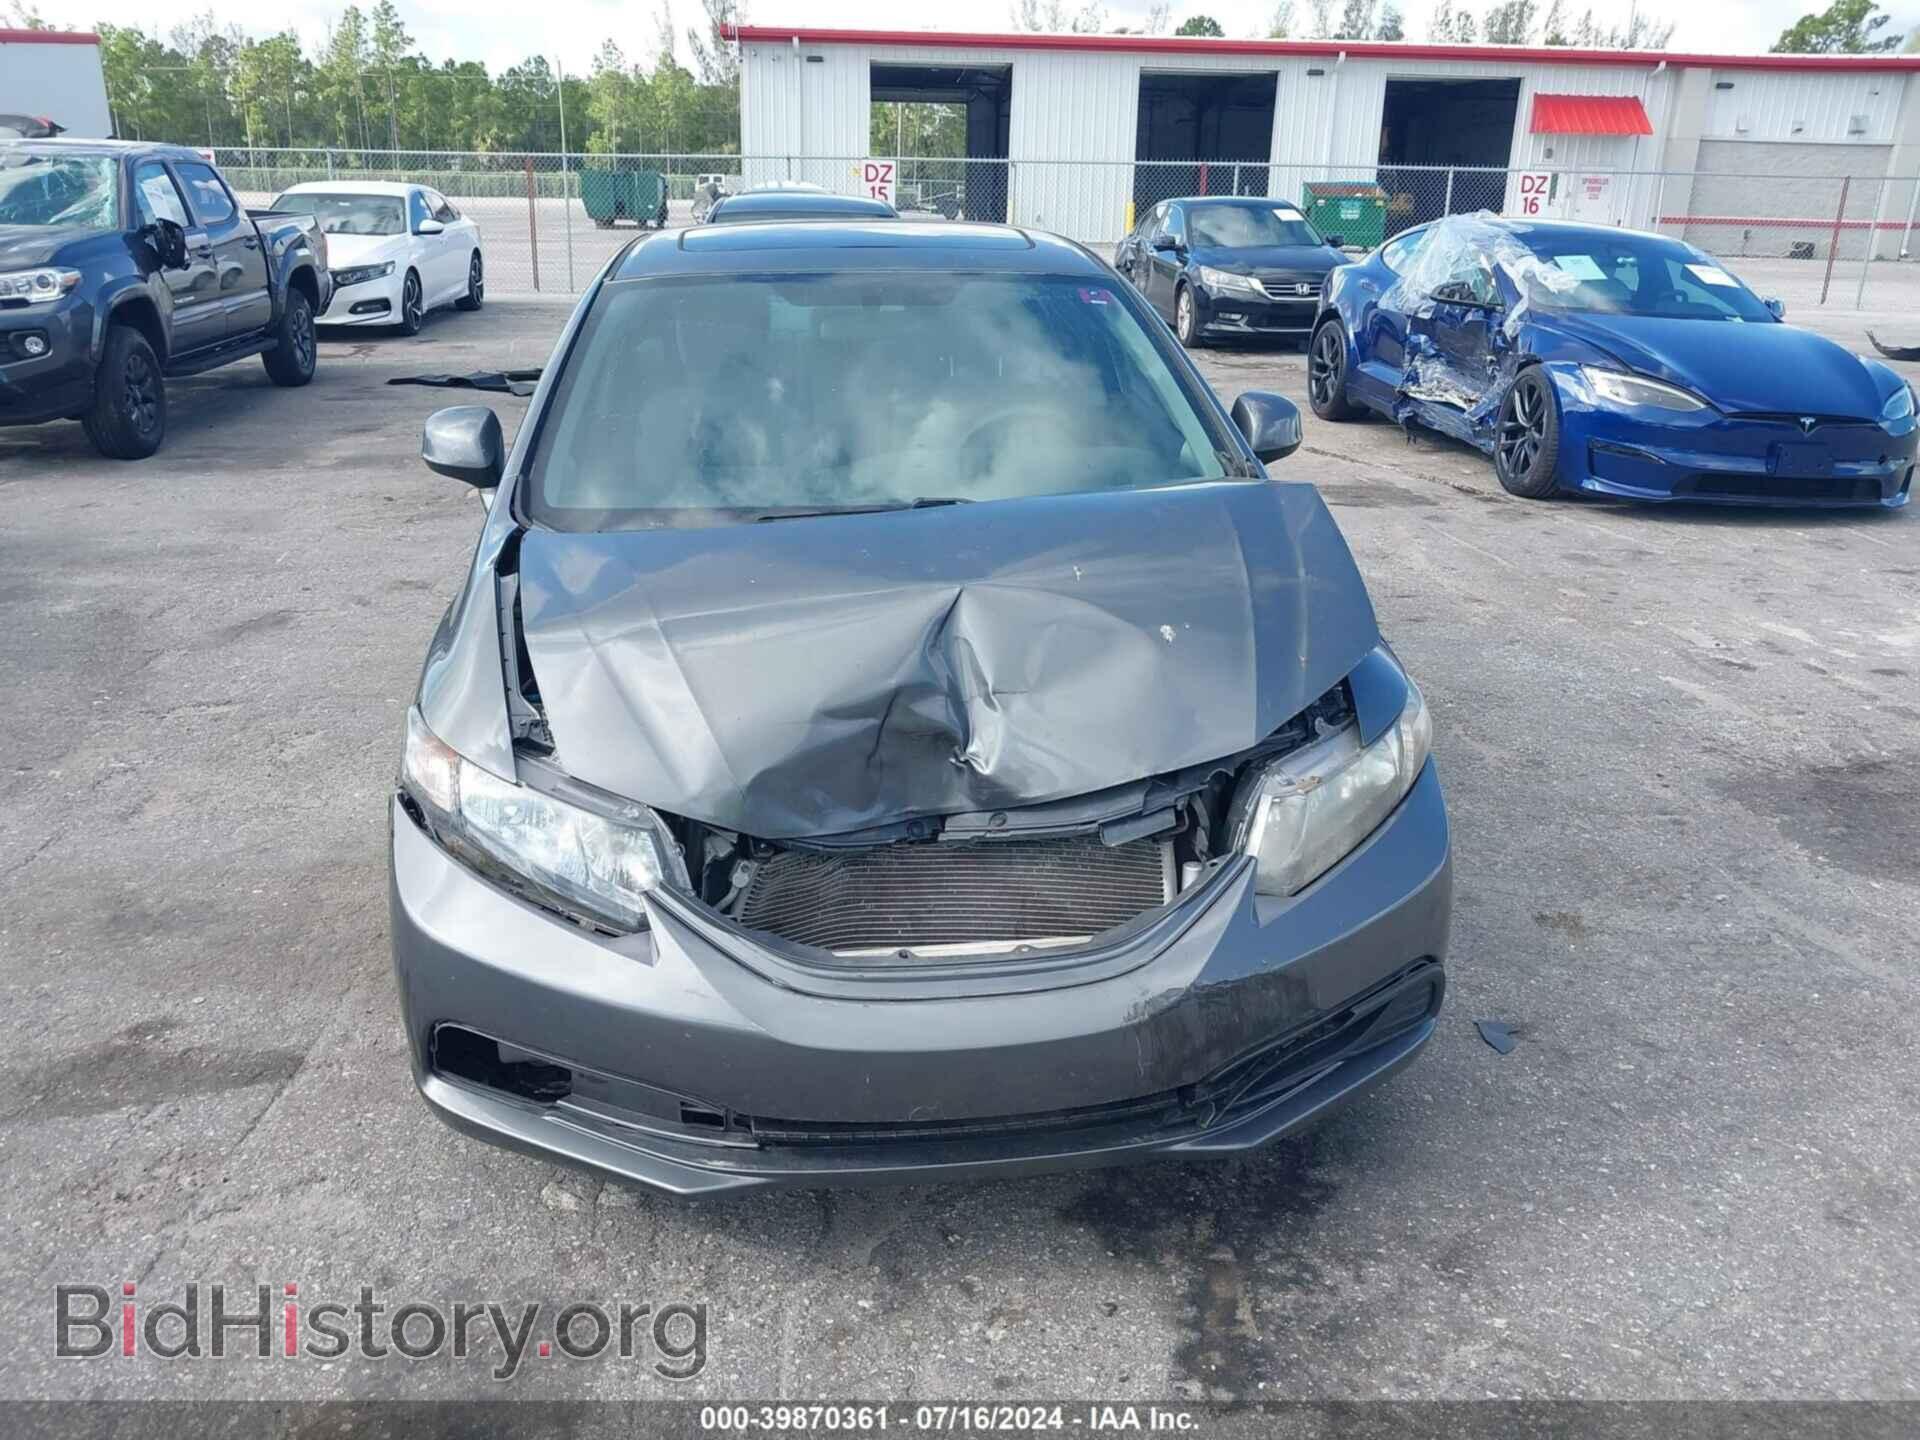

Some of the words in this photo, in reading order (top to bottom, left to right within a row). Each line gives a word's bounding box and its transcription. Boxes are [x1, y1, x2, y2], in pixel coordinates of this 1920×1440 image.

[864, 163, 893, 183] DZ
[869, 185, 889, 201] 15
[1520, 175, 1549, 194] DZ
[1522, 196, 1540, 215] 16
